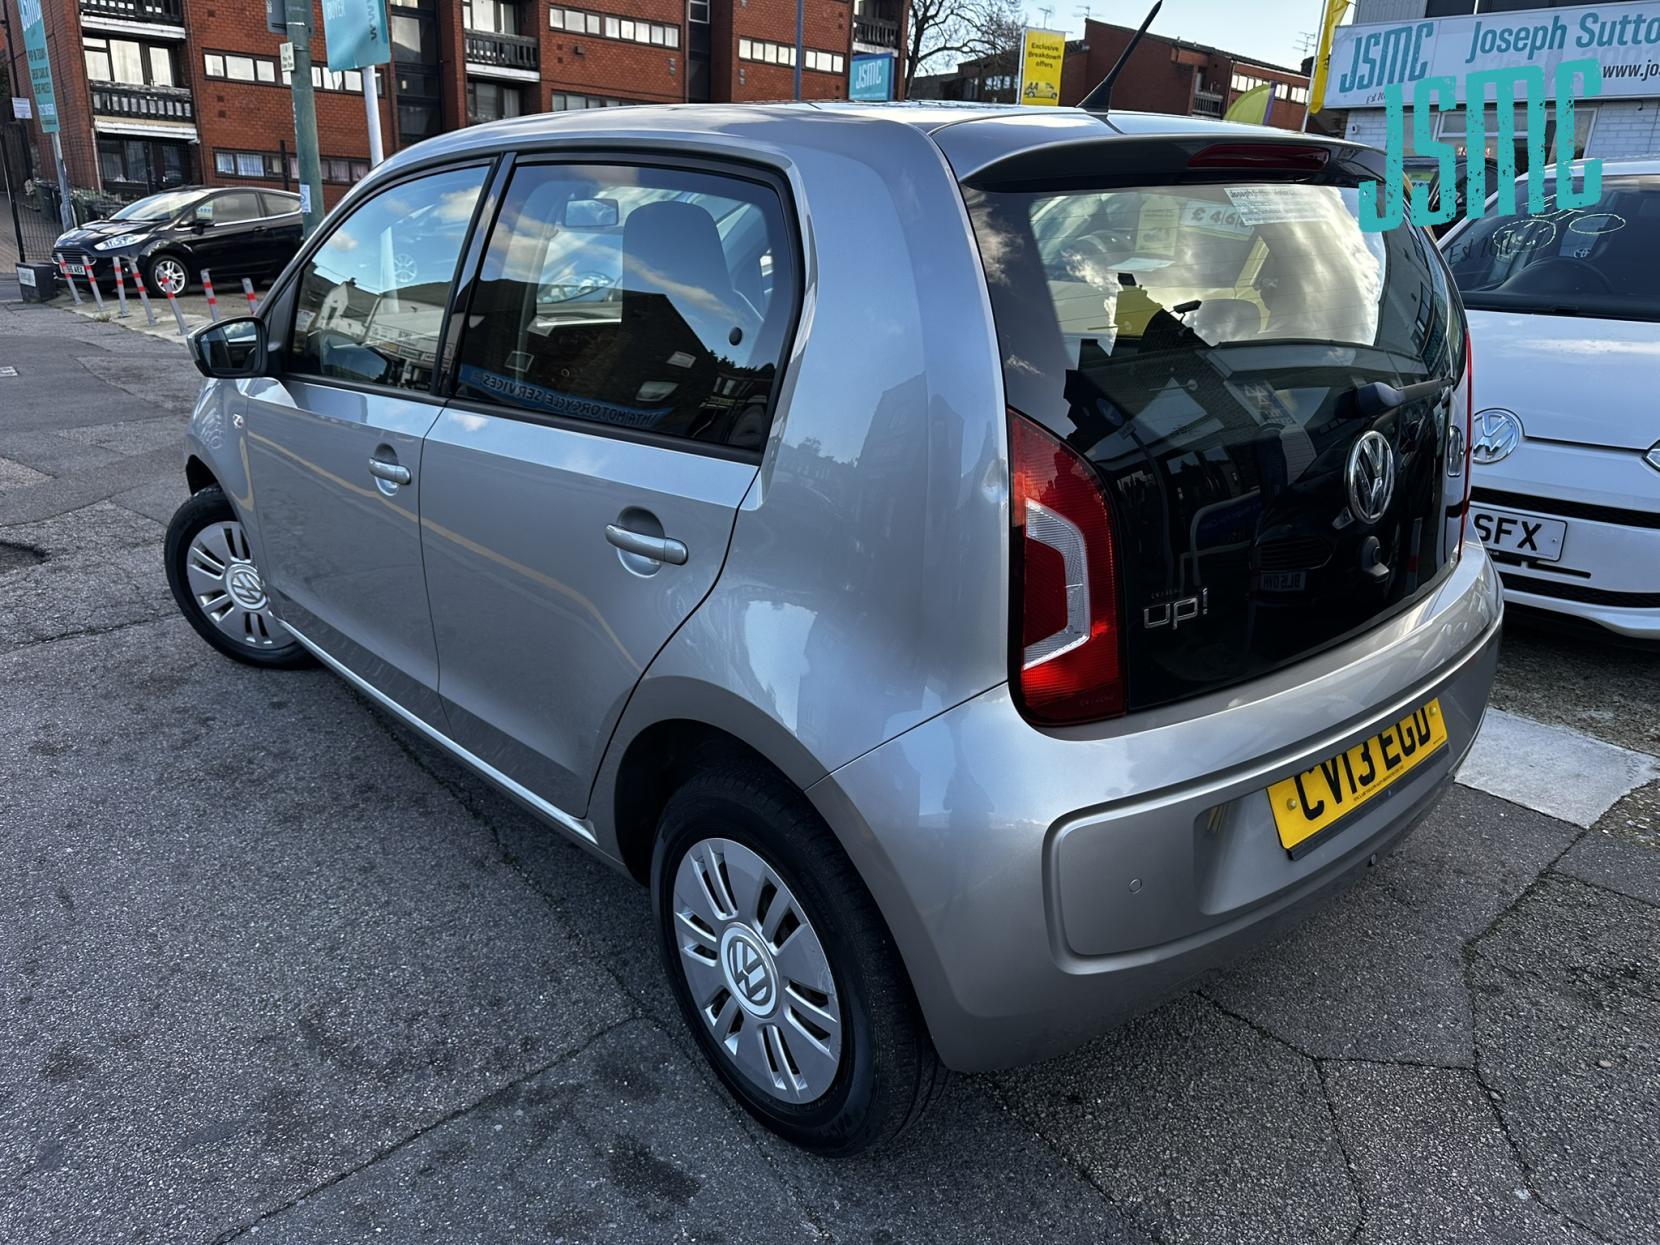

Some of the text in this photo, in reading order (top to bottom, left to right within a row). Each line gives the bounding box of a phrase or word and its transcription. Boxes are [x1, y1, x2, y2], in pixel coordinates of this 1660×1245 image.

[1027, 51, 1062, 60] Breakdown
[1031, 42, 1060, 51] Exclusive
[1338, 22, 1434, 93] JSMC
[1465, 12, 1660, 64] Joseph Sutto
[855, 60, 882, 89] JSMC
[1602, 59, 1660, 81] www.jo
[1473, 513, 1543, 552] SFX
[1143, 587, 1208, 630] up!
[1293, 741, 1376, 821] CV13
[1377, 707, 1431, 771] EGD
